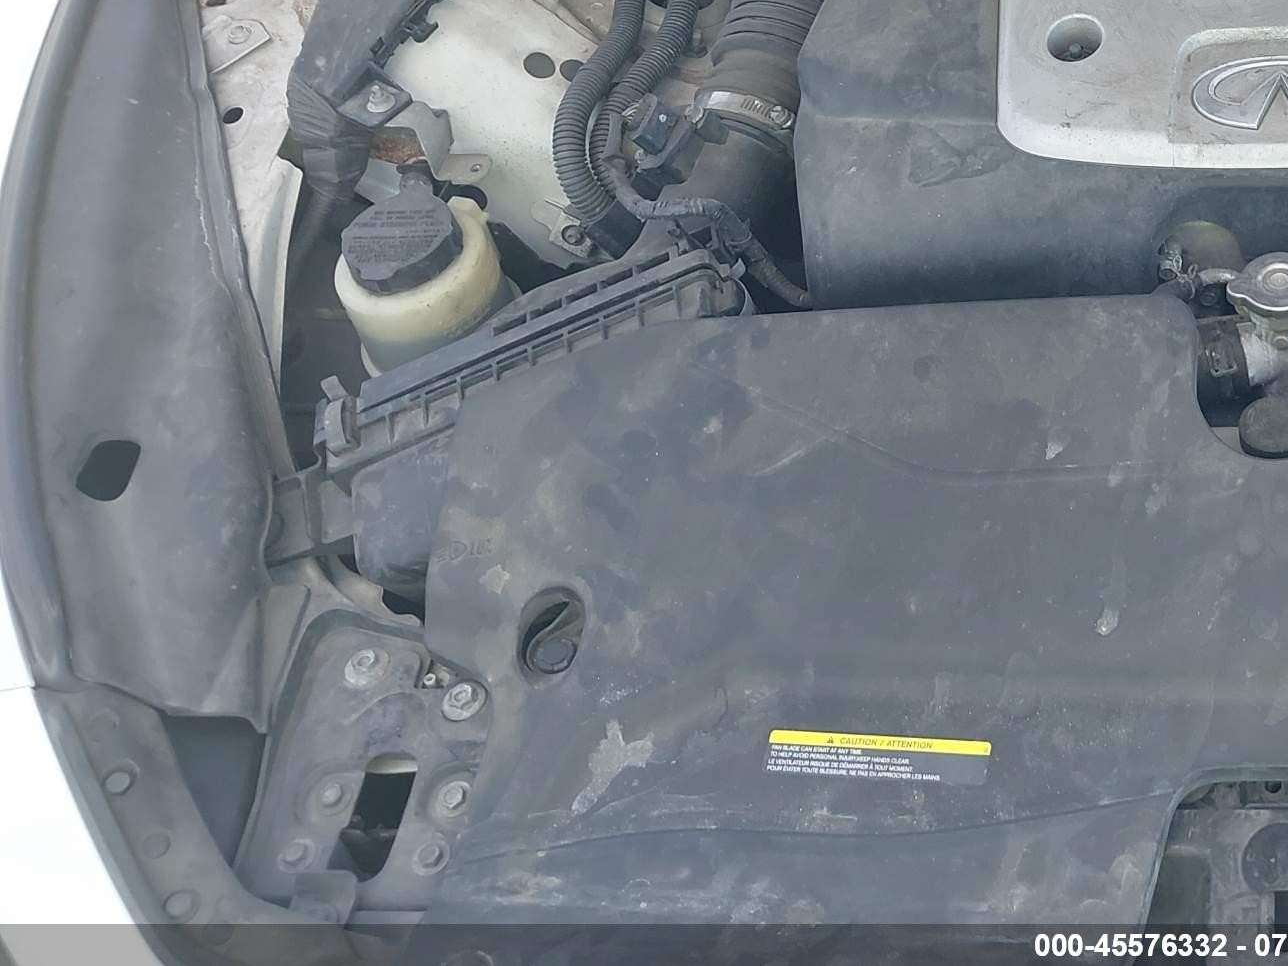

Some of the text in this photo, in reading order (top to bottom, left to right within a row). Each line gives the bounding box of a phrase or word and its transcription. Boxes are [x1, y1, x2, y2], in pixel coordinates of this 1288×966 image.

[840, 737, 877, 746] CAUTION
[886, 740, 933, 749] ATTENTION
[877, 771, 911, 779] APPROCHER
